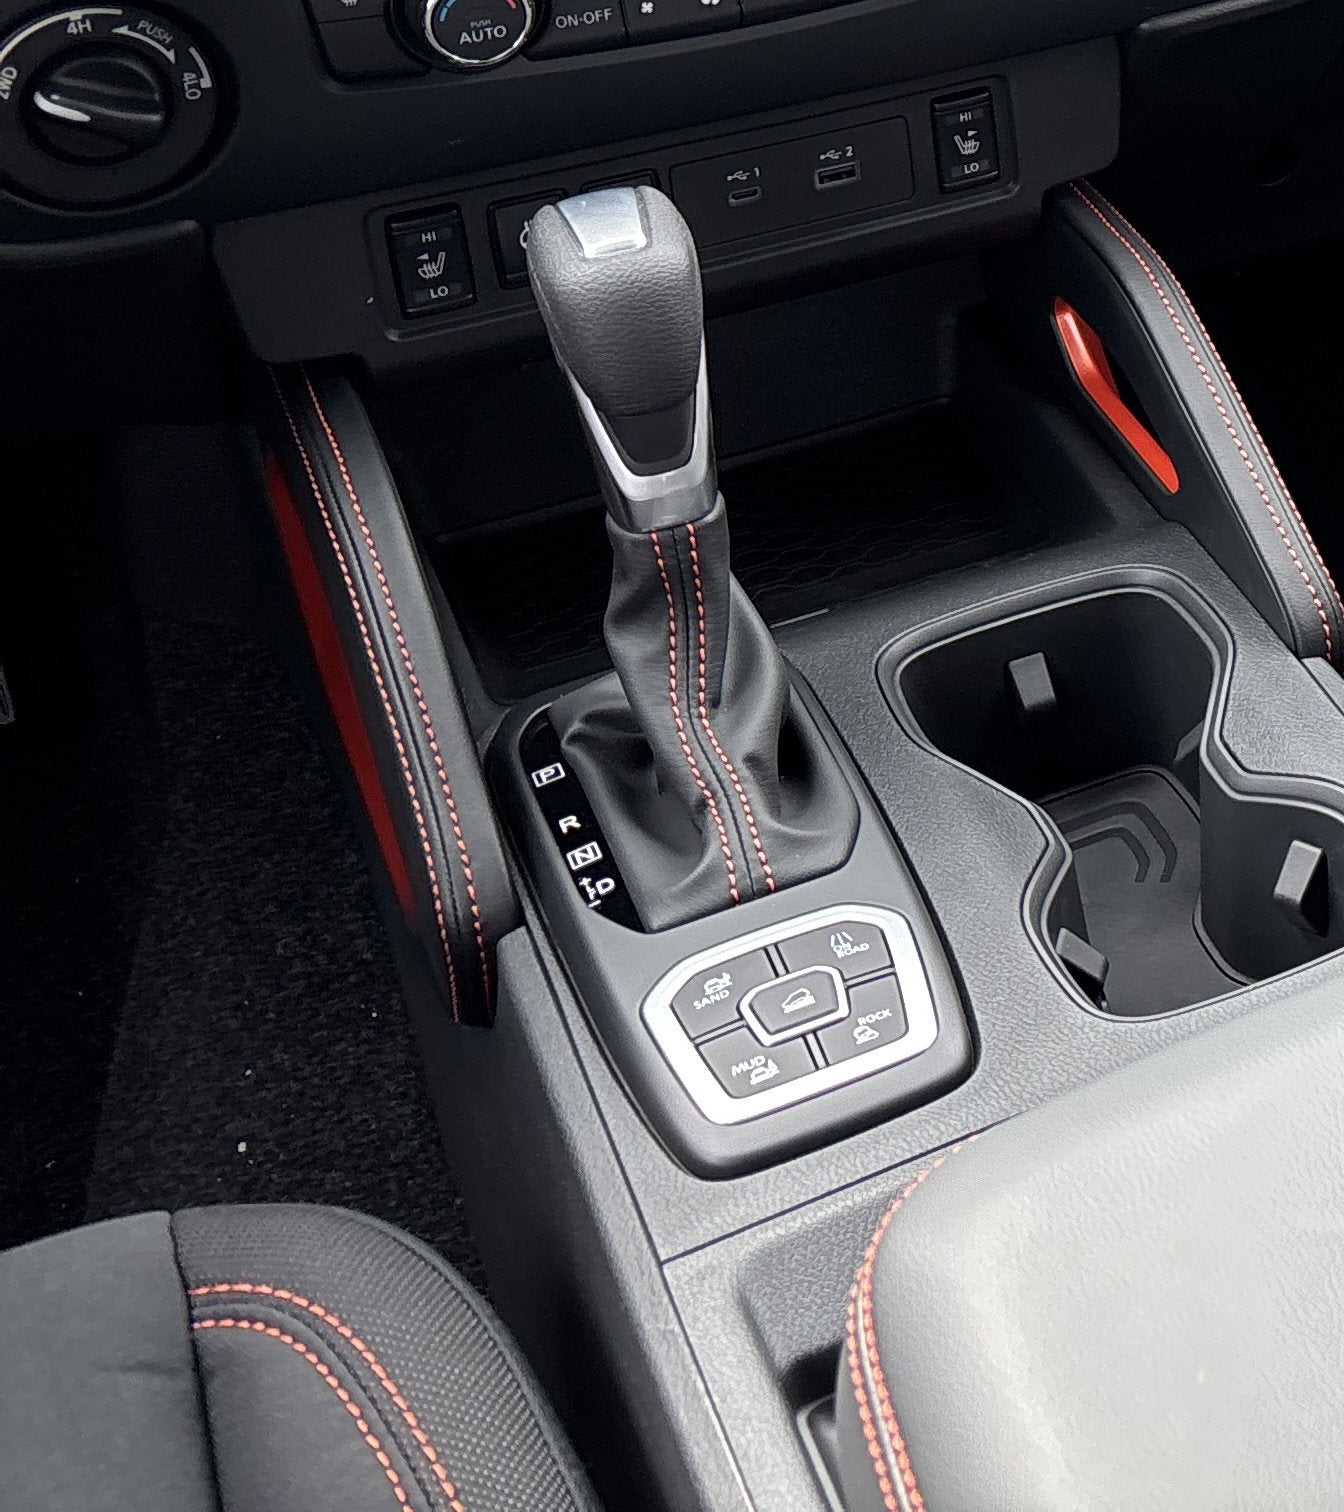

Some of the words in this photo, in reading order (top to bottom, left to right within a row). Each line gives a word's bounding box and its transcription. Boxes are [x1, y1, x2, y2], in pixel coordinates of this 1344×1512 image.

[66, 19, 92, 35] 4H
[137, 19, 174, 44] PUSH
[470, 19, 492, 28] PUSH
[459, 25, 507, 45] AUTO
[182, 71, 202, 100] 4LO
[959, 111, 972, 122] HI
[845, 145, 854, 157] 2
[753, 167, 761, 178] 1
[964, 162, 981, 174] LO
[421, 231, 437, 243] HI
[430, 285, 449, 299] LO
[558, 815, 582, 834] R
[596, 877, 616, 896] D
[837, 942, 870, 958] ROAD
[694, 989, 730, 1010] SAND
[857, 1008, 893, 1026] ROCK
[732, 1055, 766, 1077] MUD
